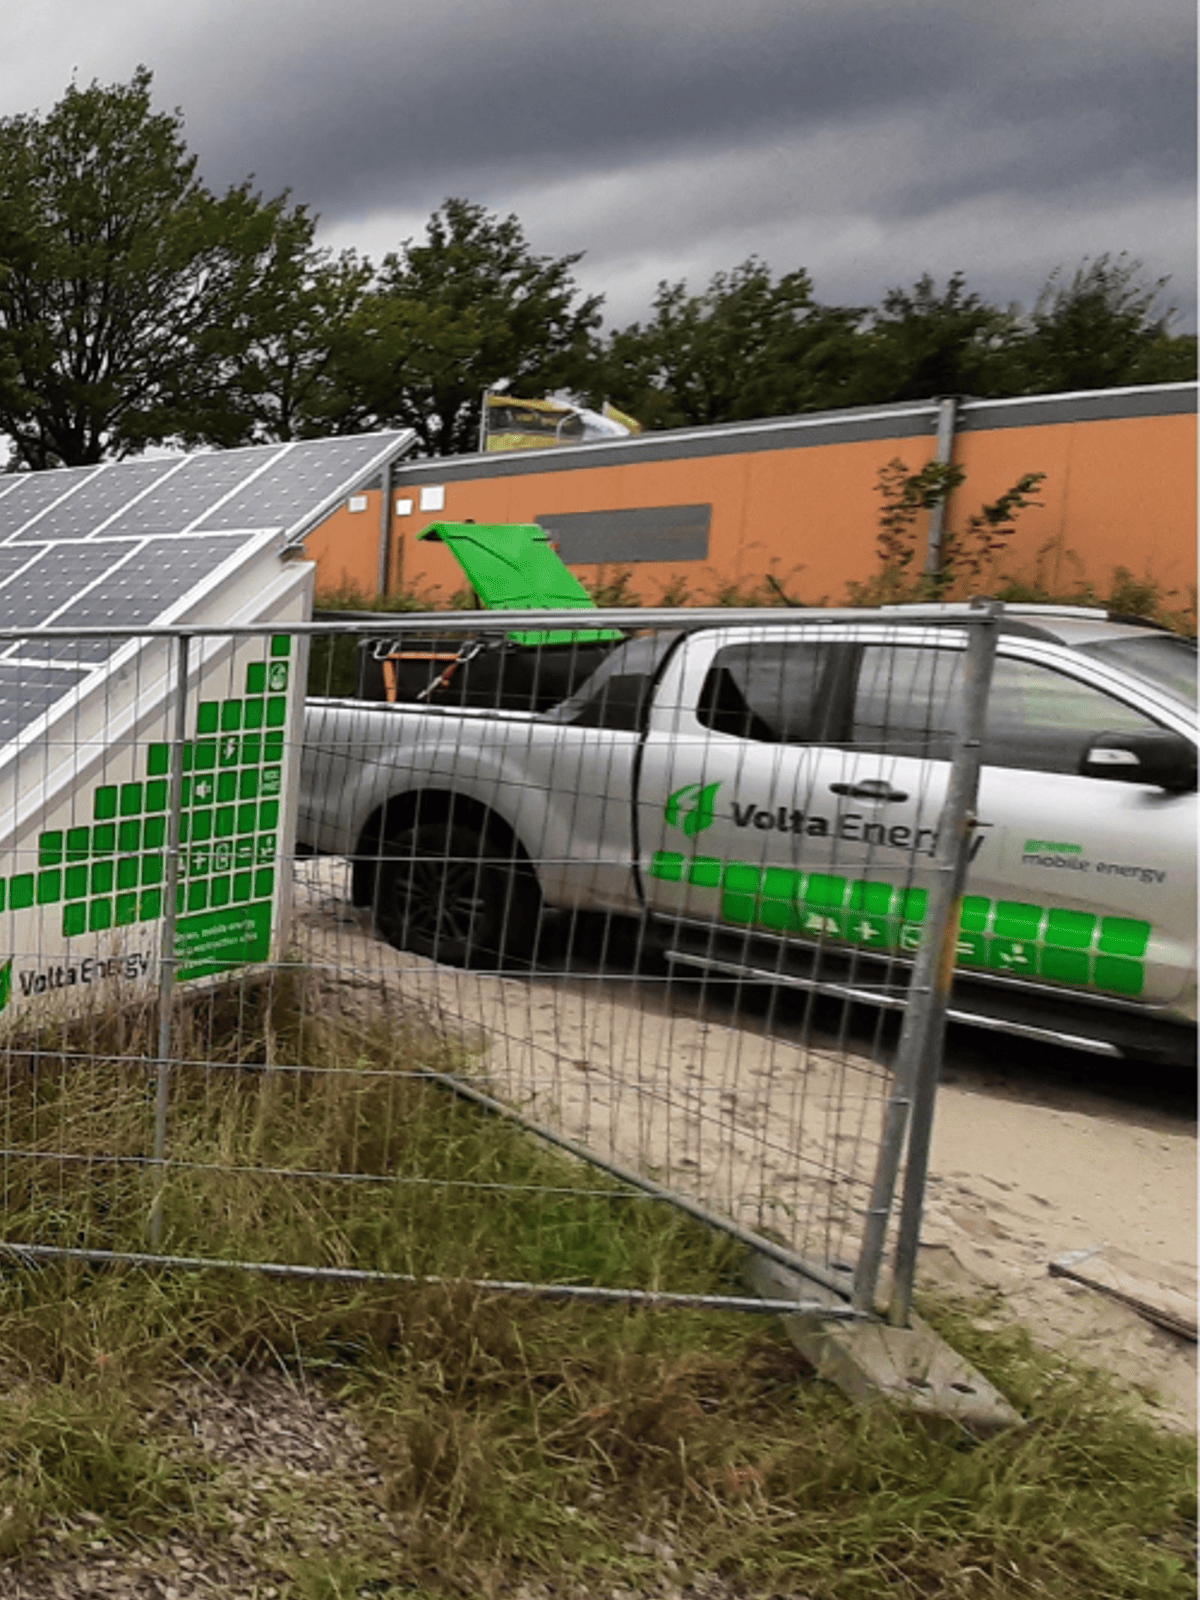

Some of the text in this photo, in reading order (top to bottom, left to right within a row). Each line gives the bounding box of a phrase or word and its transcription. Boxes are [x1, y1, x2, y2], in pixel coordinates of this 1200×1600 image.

[730, 802, 828, 836] Volta
[1022, 854, 1166, 883] mobile energy
[19, 965, 76, 996] Volta
